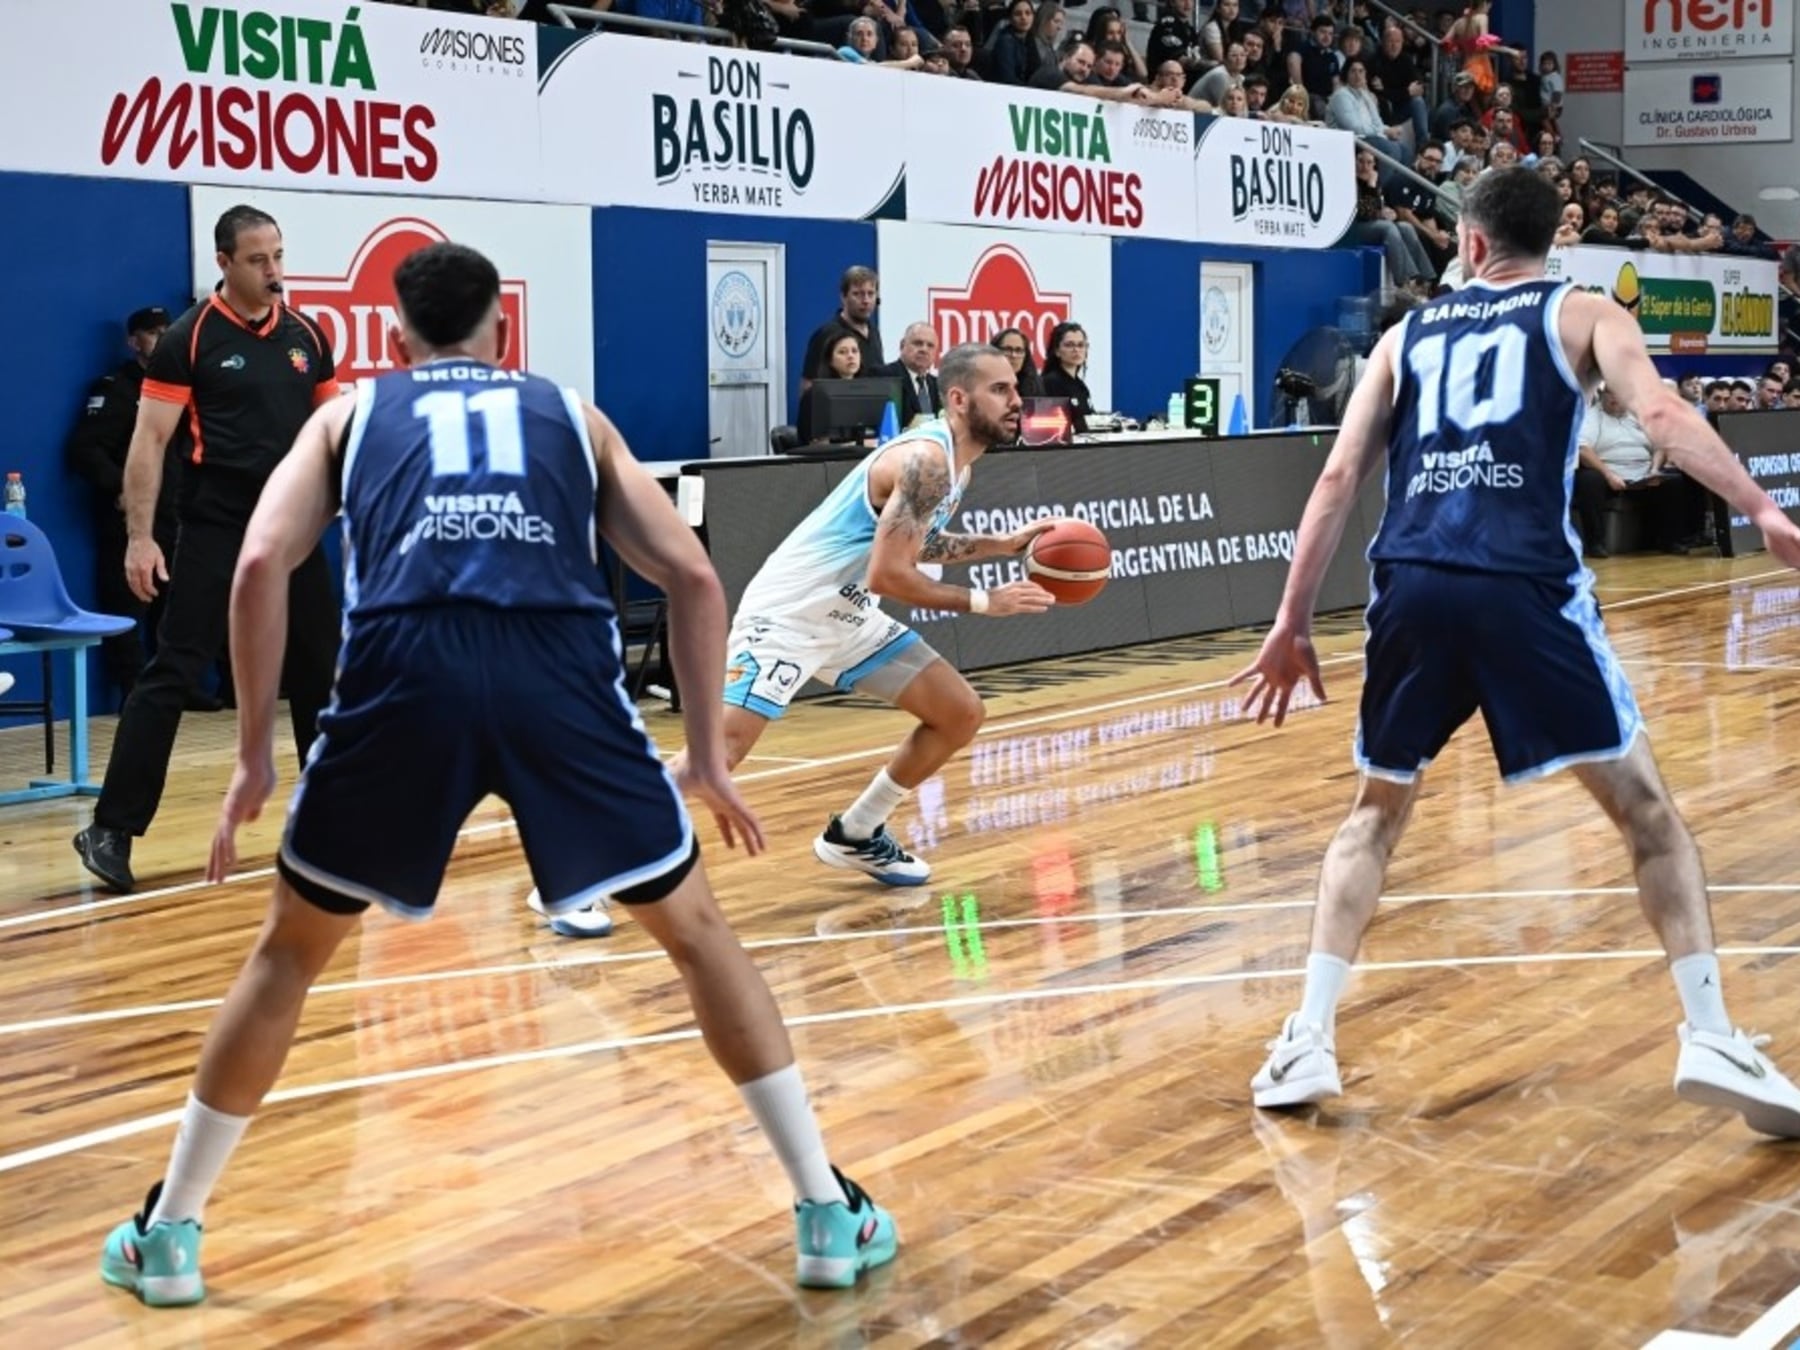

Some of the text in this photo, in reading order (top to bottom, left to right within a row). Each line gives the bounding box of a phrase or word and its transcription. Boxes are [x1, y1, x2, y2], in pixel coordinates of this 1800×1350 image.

[170, 2, 377, 91] VISITÁ
[419, 27, 525, 65] MISIONES
[1643, 33, 1771, 49] INGENIERIA
[708, 56, 762, 99] DON
[100, 76, 438, 182] MISIONES
[1008, 103, 1112, 164] VISITÁ
[1640, 107, 1773, 124] CLÍNICA CARDIOLÓGICA
[1656, 124, 1757, 138] Dr. Gustavo Urbina
[652, 93, 815, 189] BASILIO
[1261, 125, 1293, 157] DON
[693, 183, 782, 207] YERBA MATE
[973, 155, 1144, 228] MISIONES
[1230, 154, 1324, 223] BASILIO
[1283, 221, 1305, 238] MATE
[1421, 291, 1542, 324] SANSIMONI
[412, 367, 527, 382] BROCAL
[1408, 322, 1528, 440] 10
[1192, 384, 1213, 424] 3
[412, 387, 527, 478] 11
[1422, 441, 1495, 471] VISITÁ
[424, 491, 525, 514] VISITÁ
[1405, 464, 1524, 504] MISIONES
[1157, 494, 1185, 523] DE
[1187, 492, 1214, 520] LA
[400, 513, 556, 555] MISIONES
[1107, 539, 1215, 579] RGENTINA
[1217, 535, 1243, 565] DE
